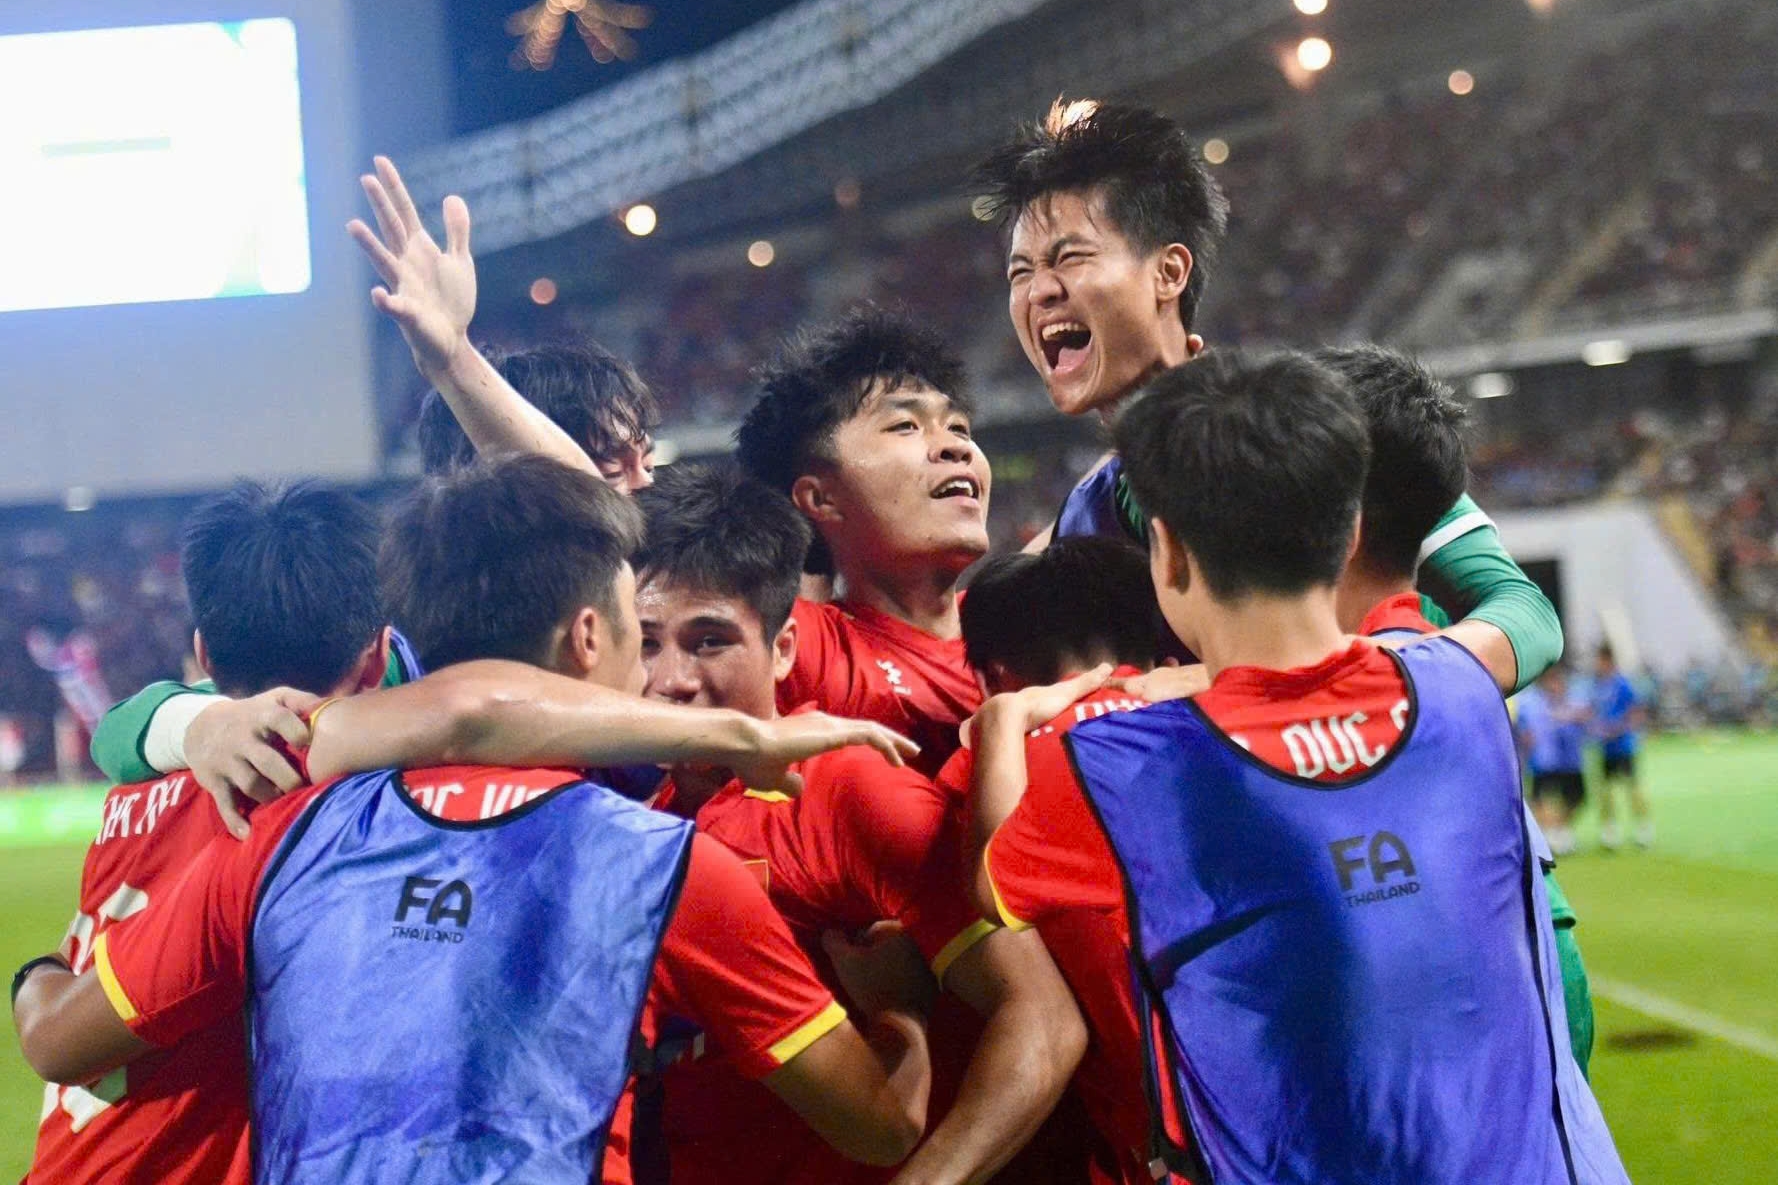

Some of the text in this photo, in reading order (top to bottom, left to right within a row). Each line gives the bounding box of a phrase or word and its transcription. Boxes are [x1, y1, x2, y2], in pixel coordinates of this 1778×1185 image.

[1328, 831, 1416, 891] FA
[394, 876, 472, 927] FA
[1347, 881, 1420, 907] THAILAND
[392, 926, 464, 944] THAILAND
